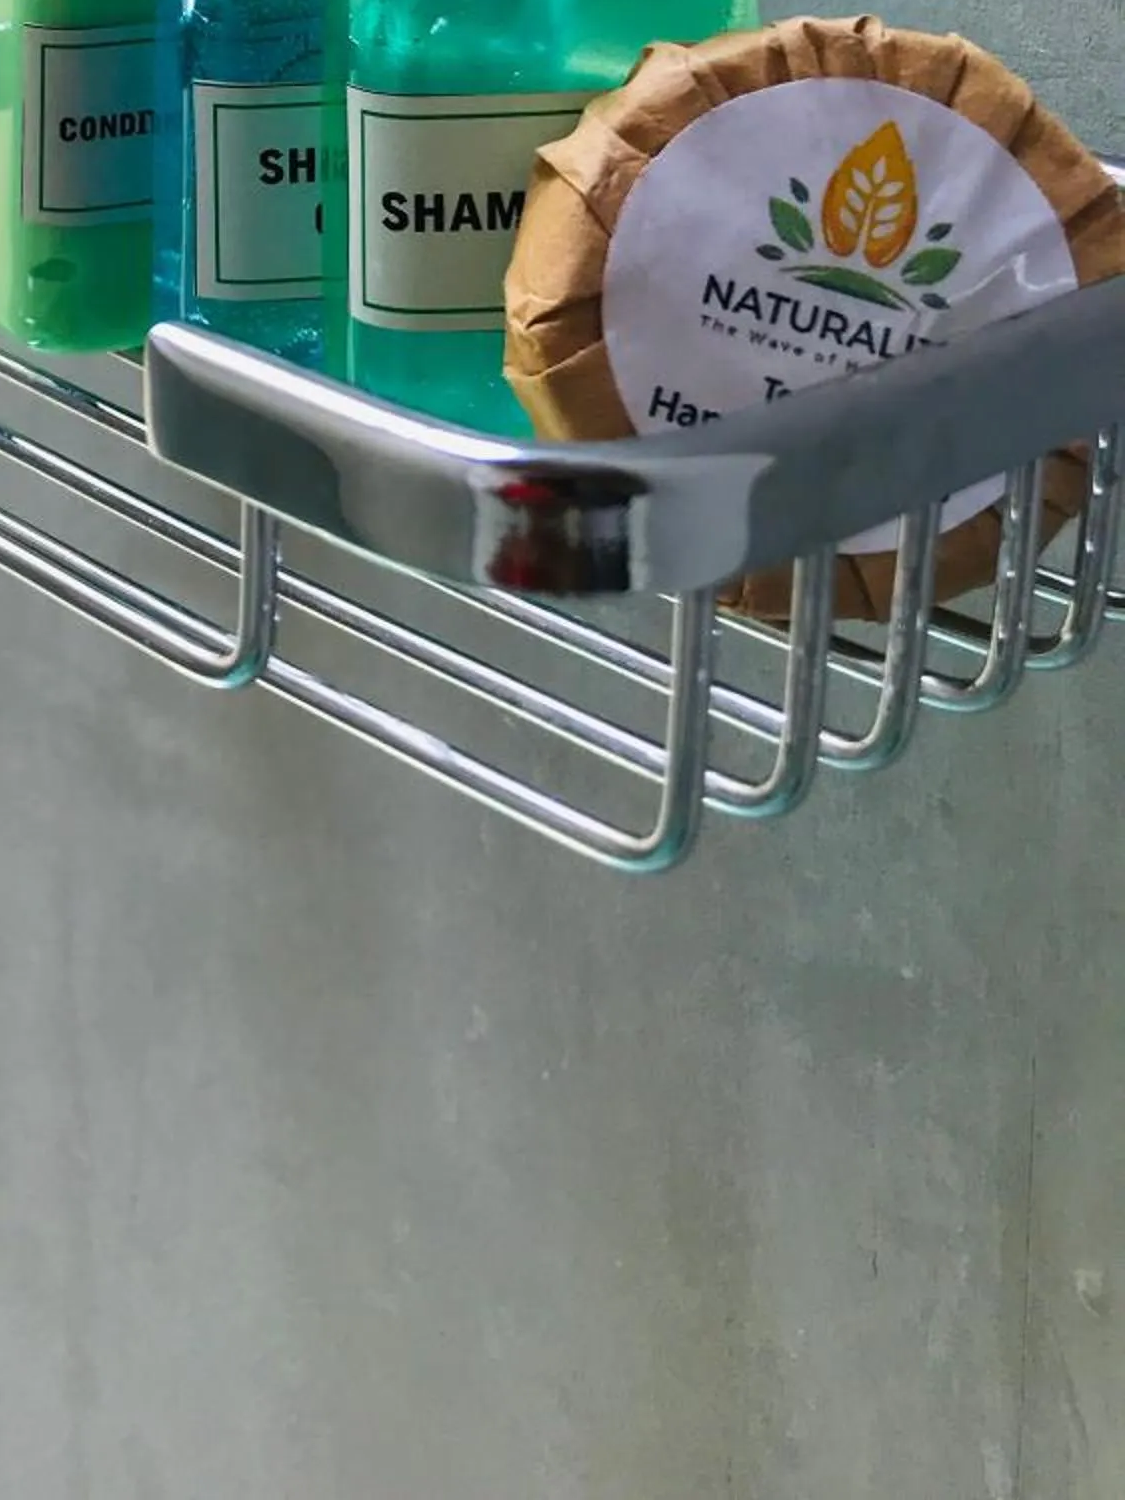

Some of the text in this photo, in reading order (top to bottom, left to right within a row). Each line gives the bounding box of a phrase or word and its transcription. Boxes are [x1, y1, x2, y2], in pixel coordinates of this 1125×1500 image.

[259, 148, 317, 185] SH
[700, 314, 738, 337] The
[702, 274, 948, 359] NATURALI
